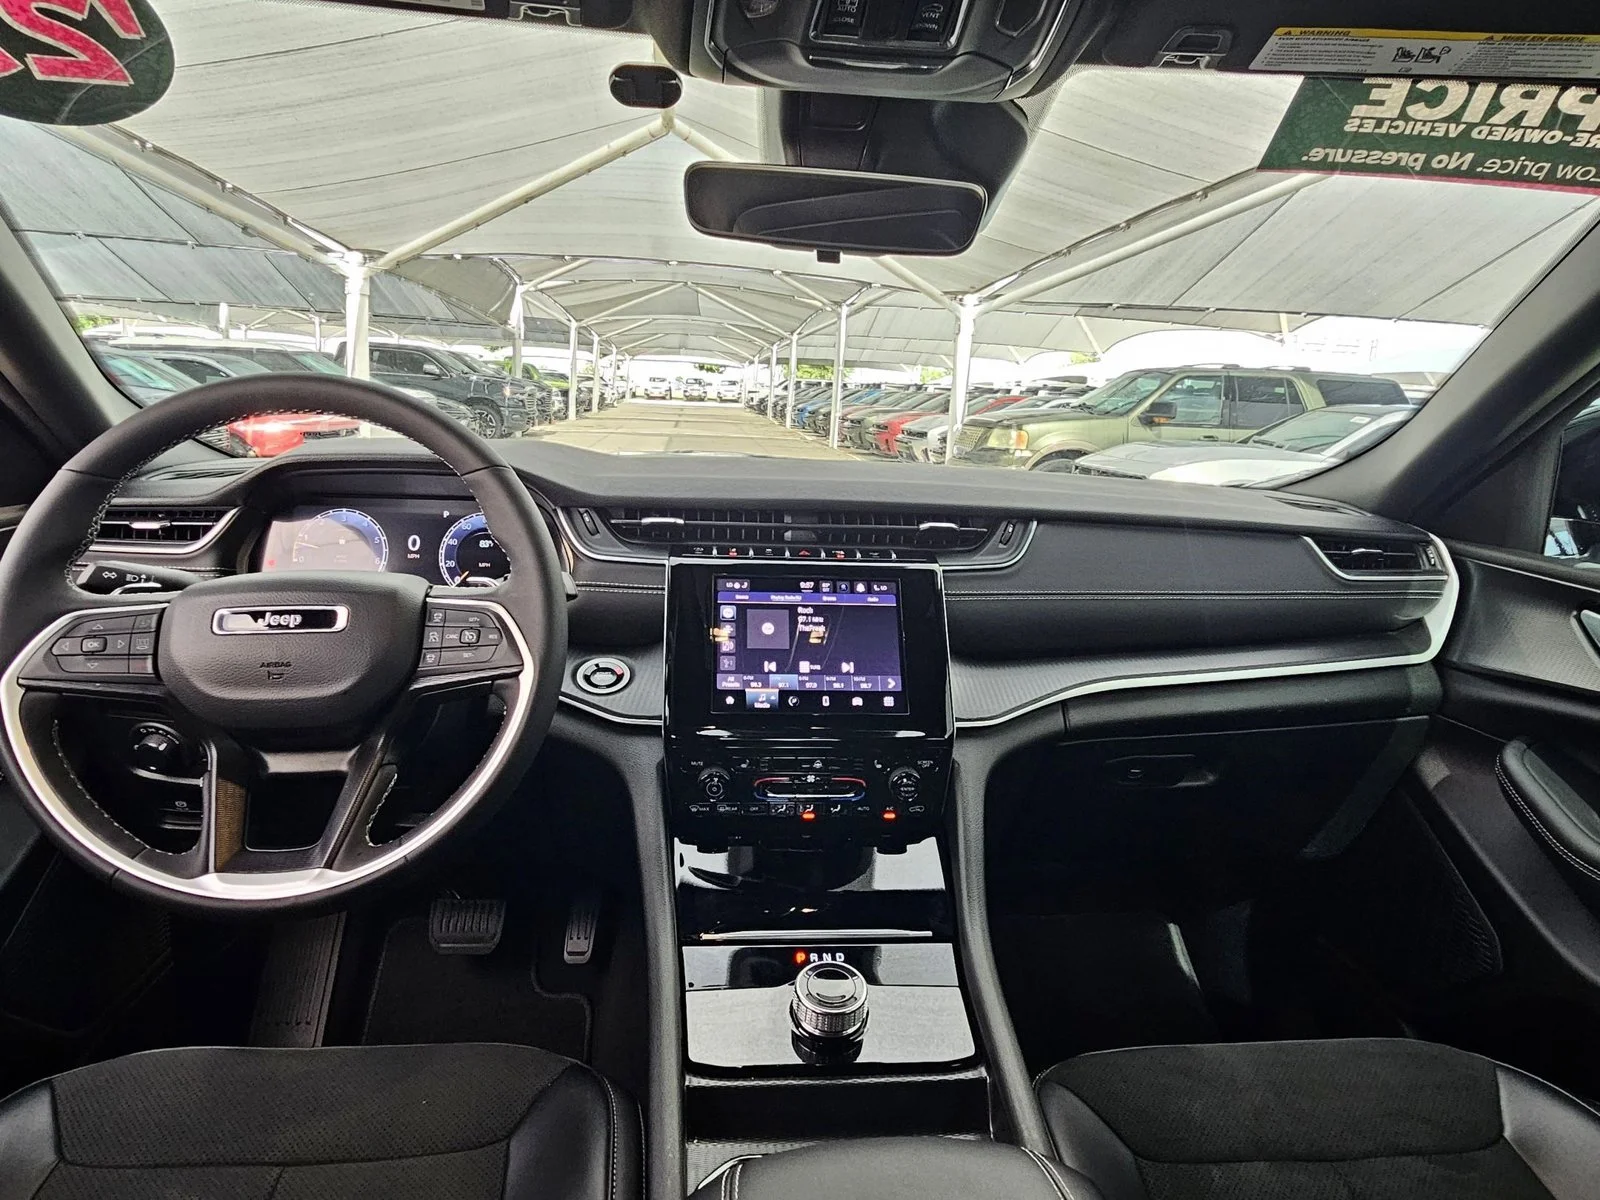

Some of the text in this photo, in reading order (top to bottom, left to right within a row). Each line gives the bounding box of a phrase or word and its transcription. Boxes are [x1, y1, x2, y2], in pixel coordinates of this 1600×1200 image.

[443, 510, 450, 518] P
[407, 534, 421, 552] 0
[447, 538, 458, 546] 40
[445, 560, 456, 568] 20
[797, 606, 814, 614] Rock
[257, 612, 302, 628] Jeep
[797, 615, 811, 623] 97.1
[796, 952, 845, 964] P R N D
